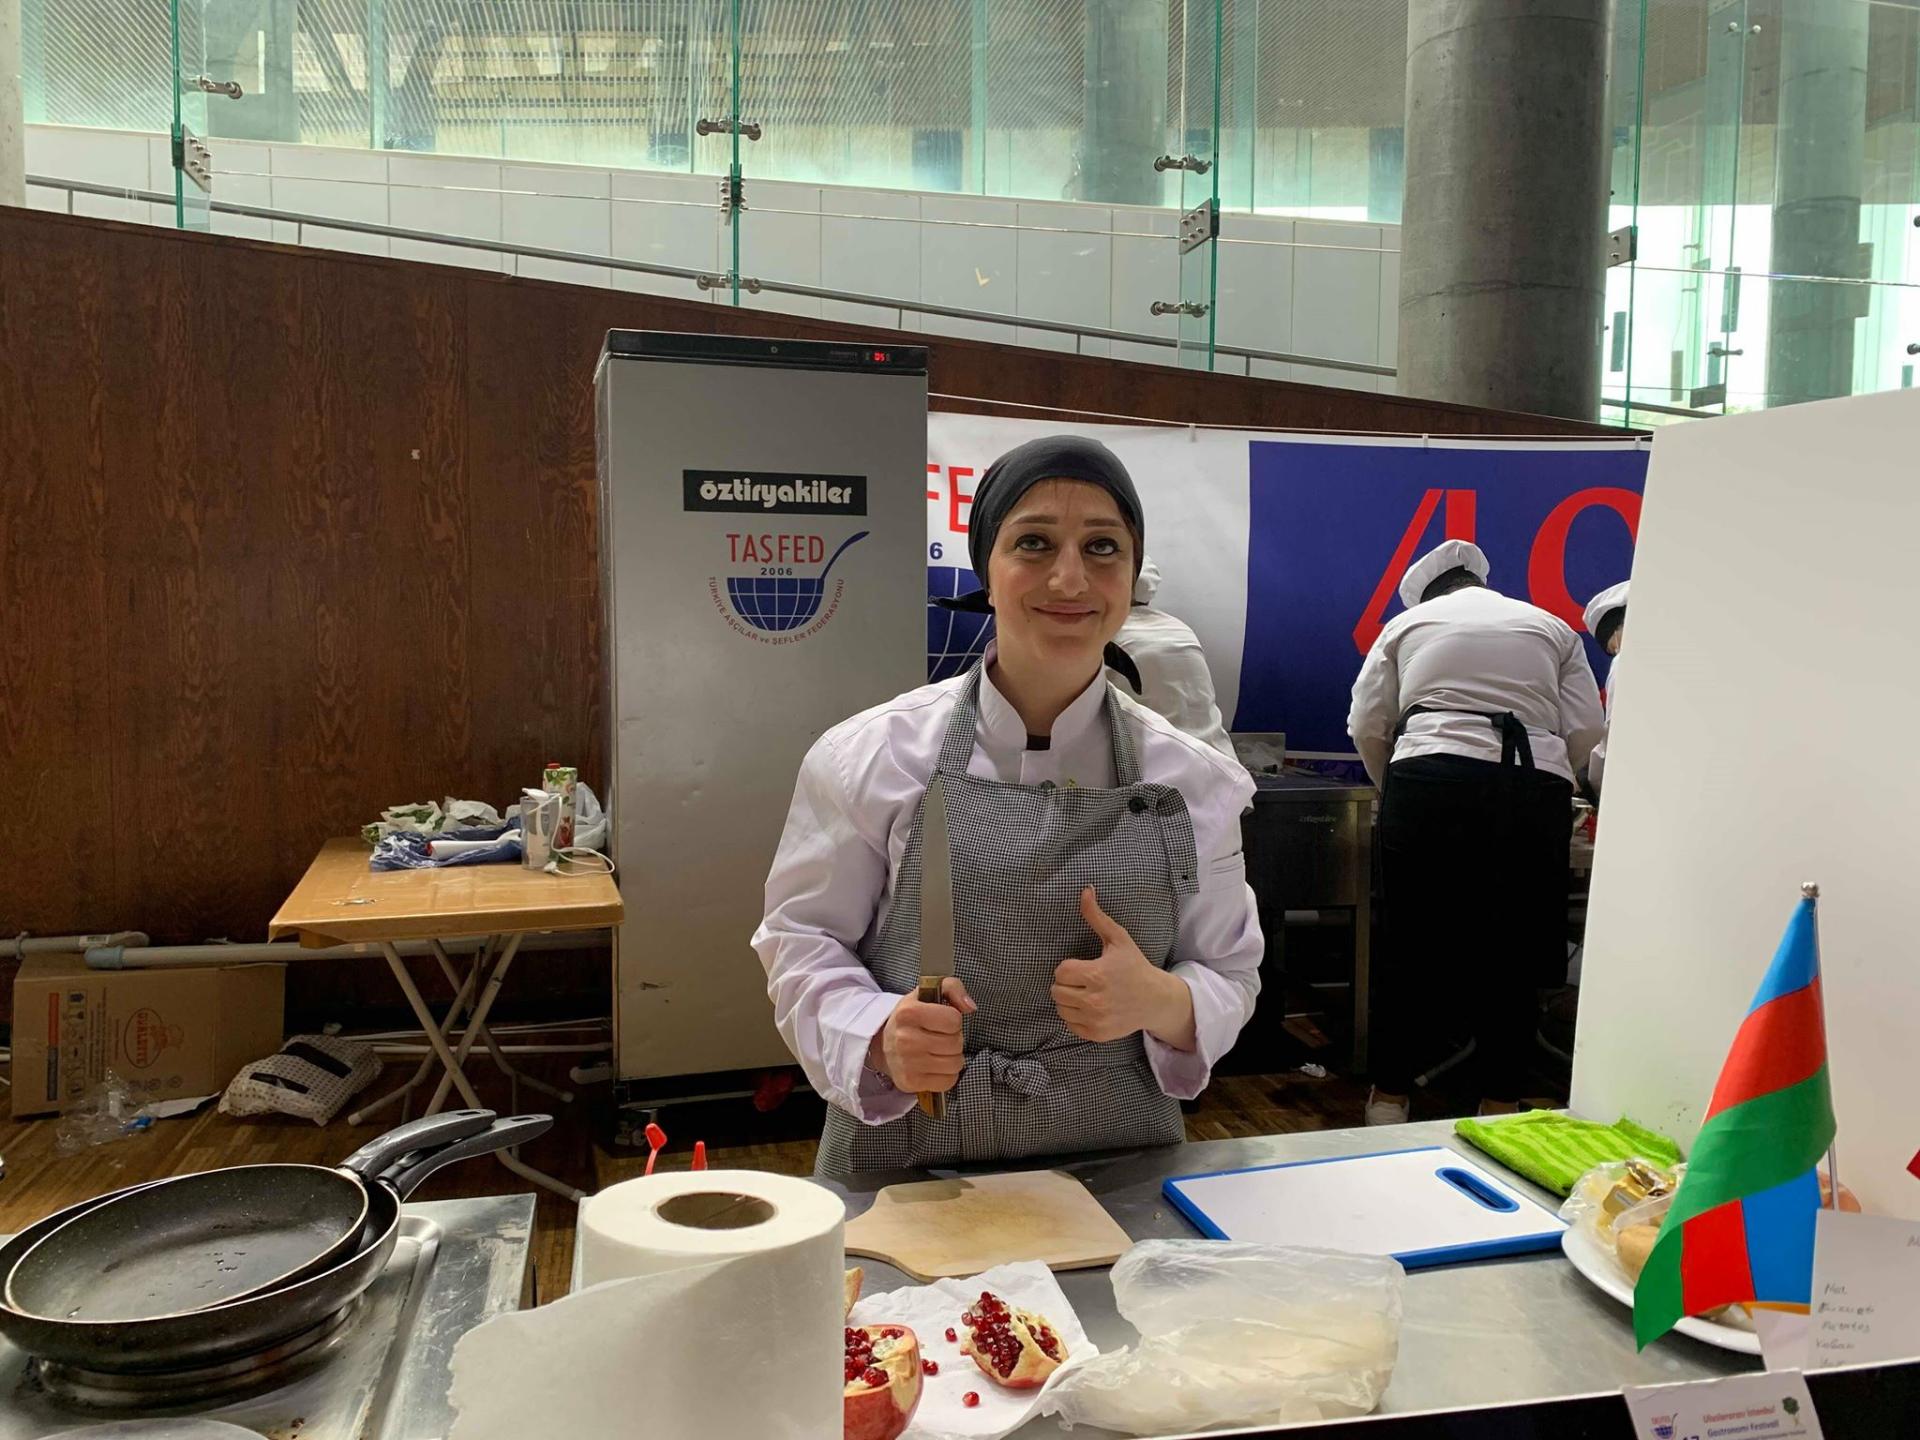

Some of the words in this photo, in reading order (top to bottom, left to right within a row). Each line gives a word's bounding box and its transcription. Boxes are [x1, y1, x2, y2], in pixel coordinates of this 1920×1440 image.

[726, 533, 825, 563] TAŞFED
[761, 567, 793, 577] 2006
[807, 578, 845, 637] FEDERASYONU
